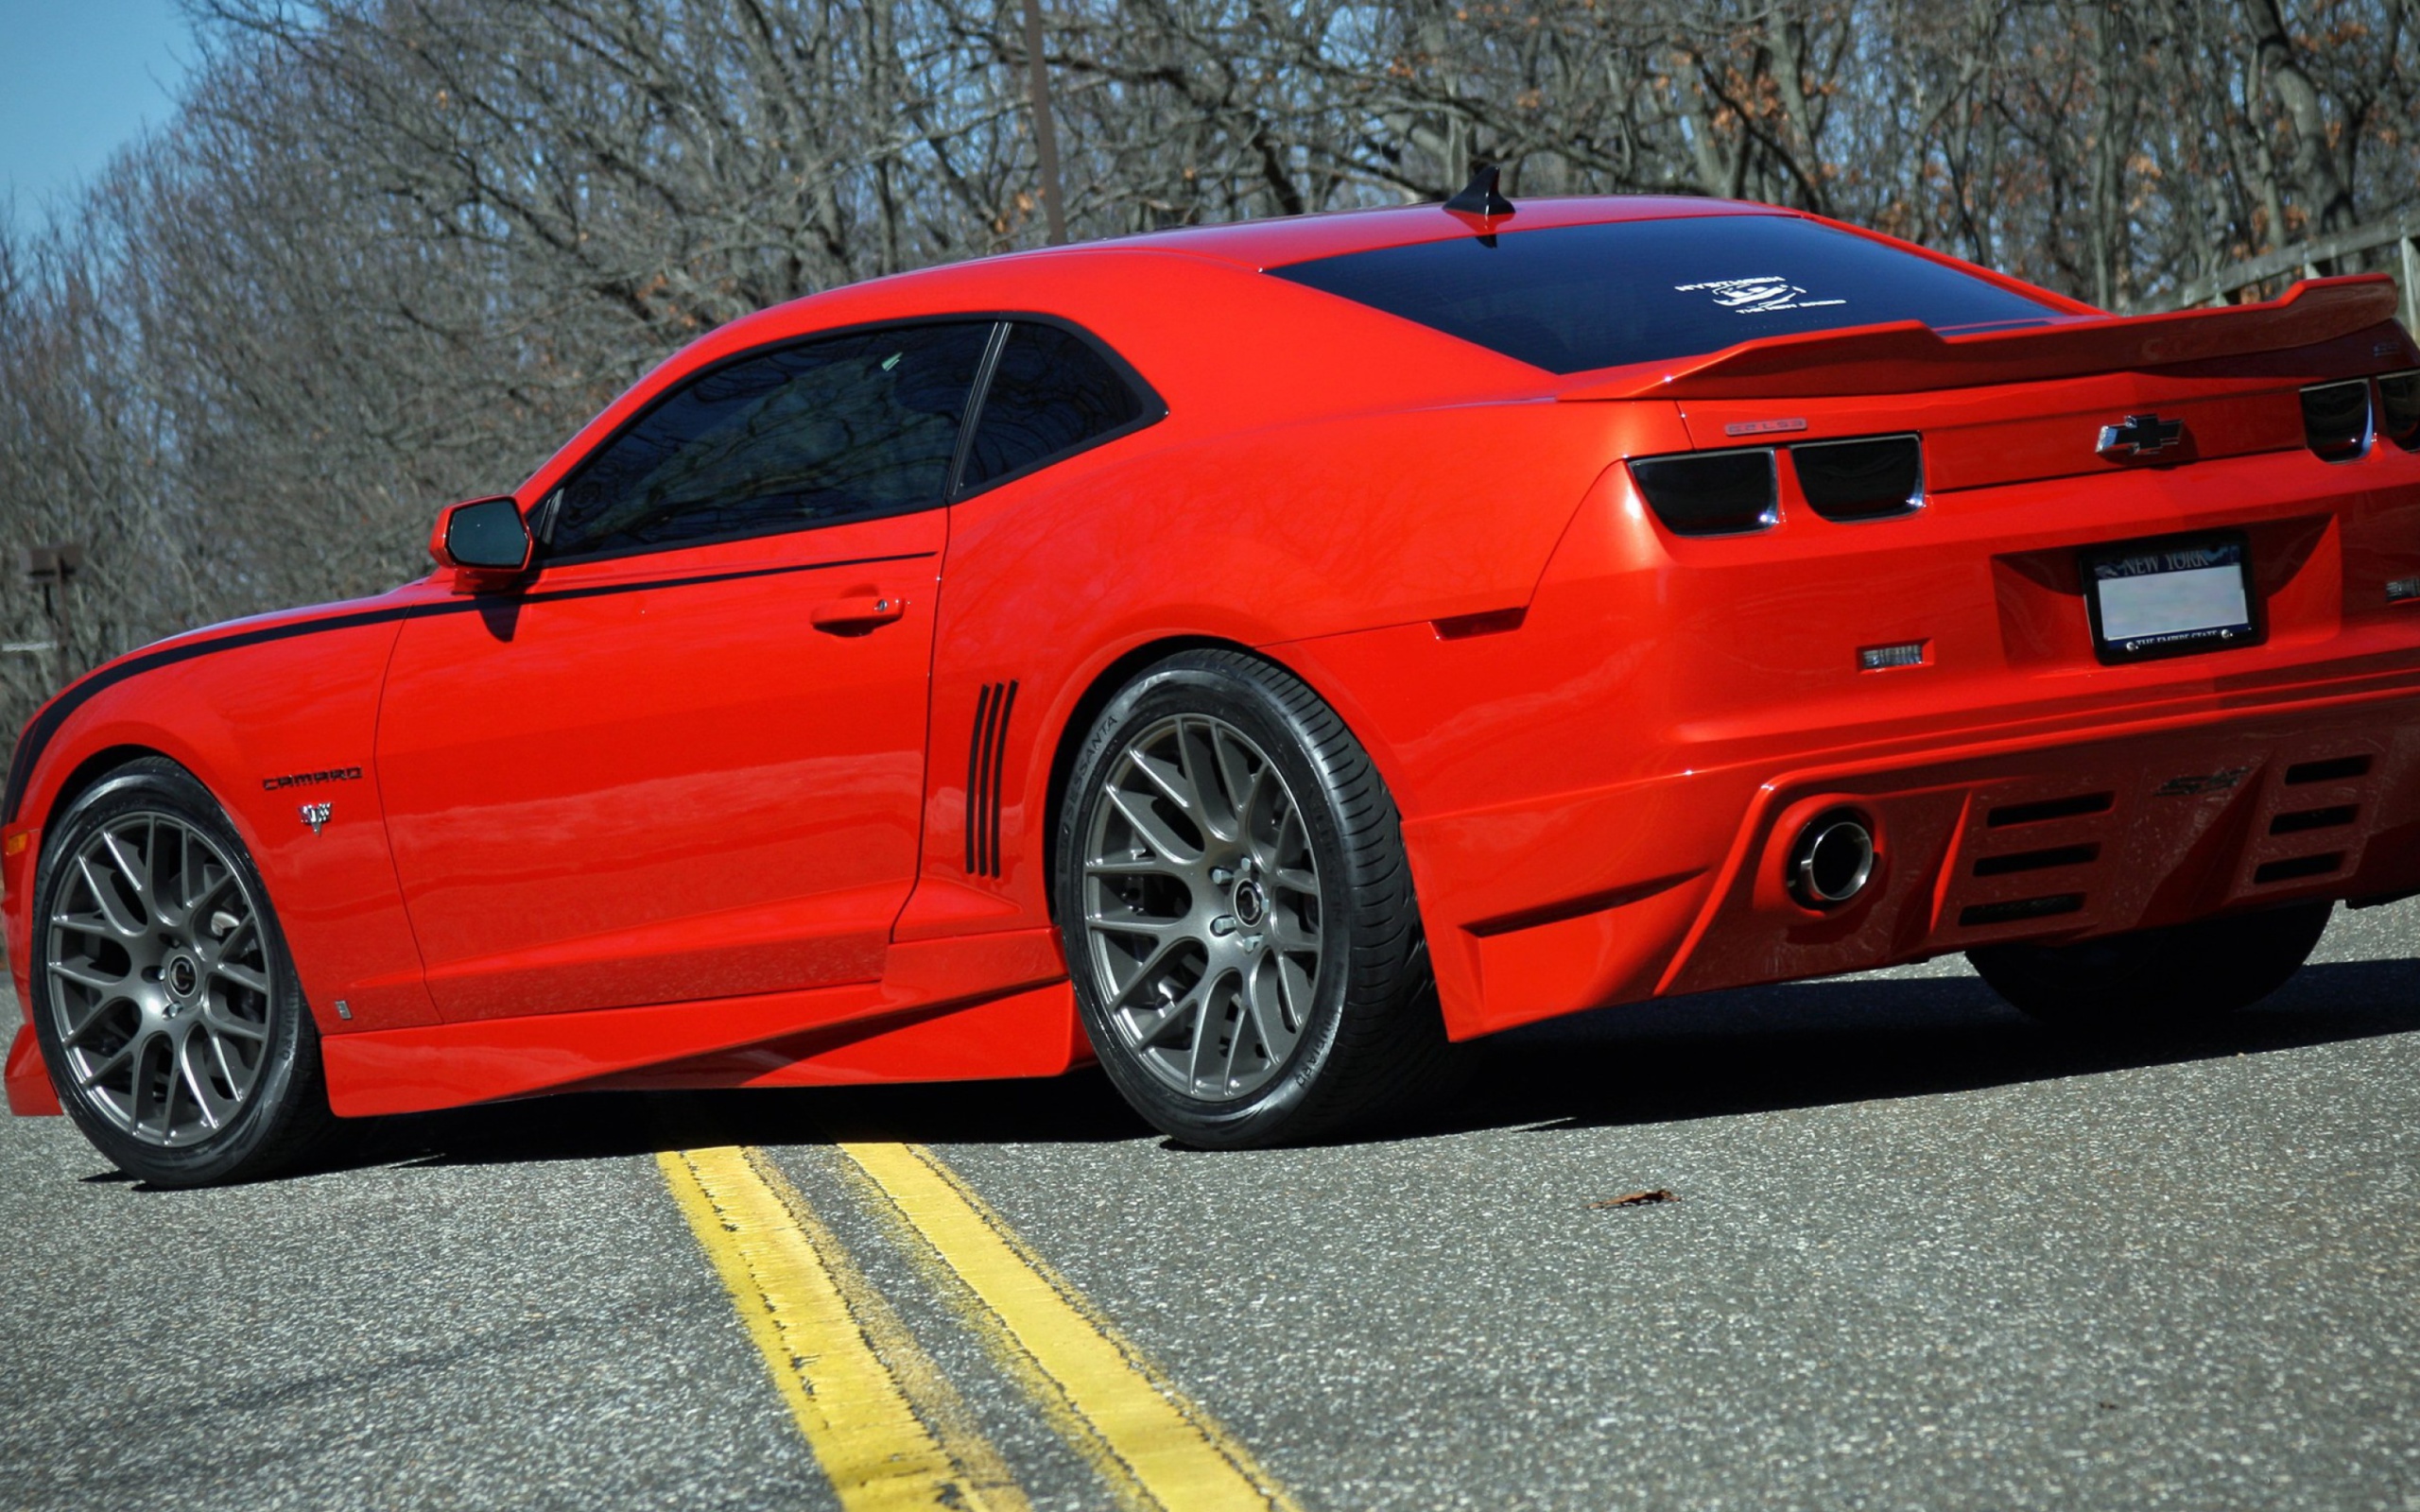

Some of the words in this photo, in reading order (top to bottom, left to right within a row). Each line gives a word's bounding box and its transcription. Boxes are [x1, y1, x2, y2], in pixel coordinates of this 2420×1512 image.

[2124, 556, 2159, 576] NEW
[2165, 550, 2209, 571] YORK
[263, 766, 363, 790] CAMARO
